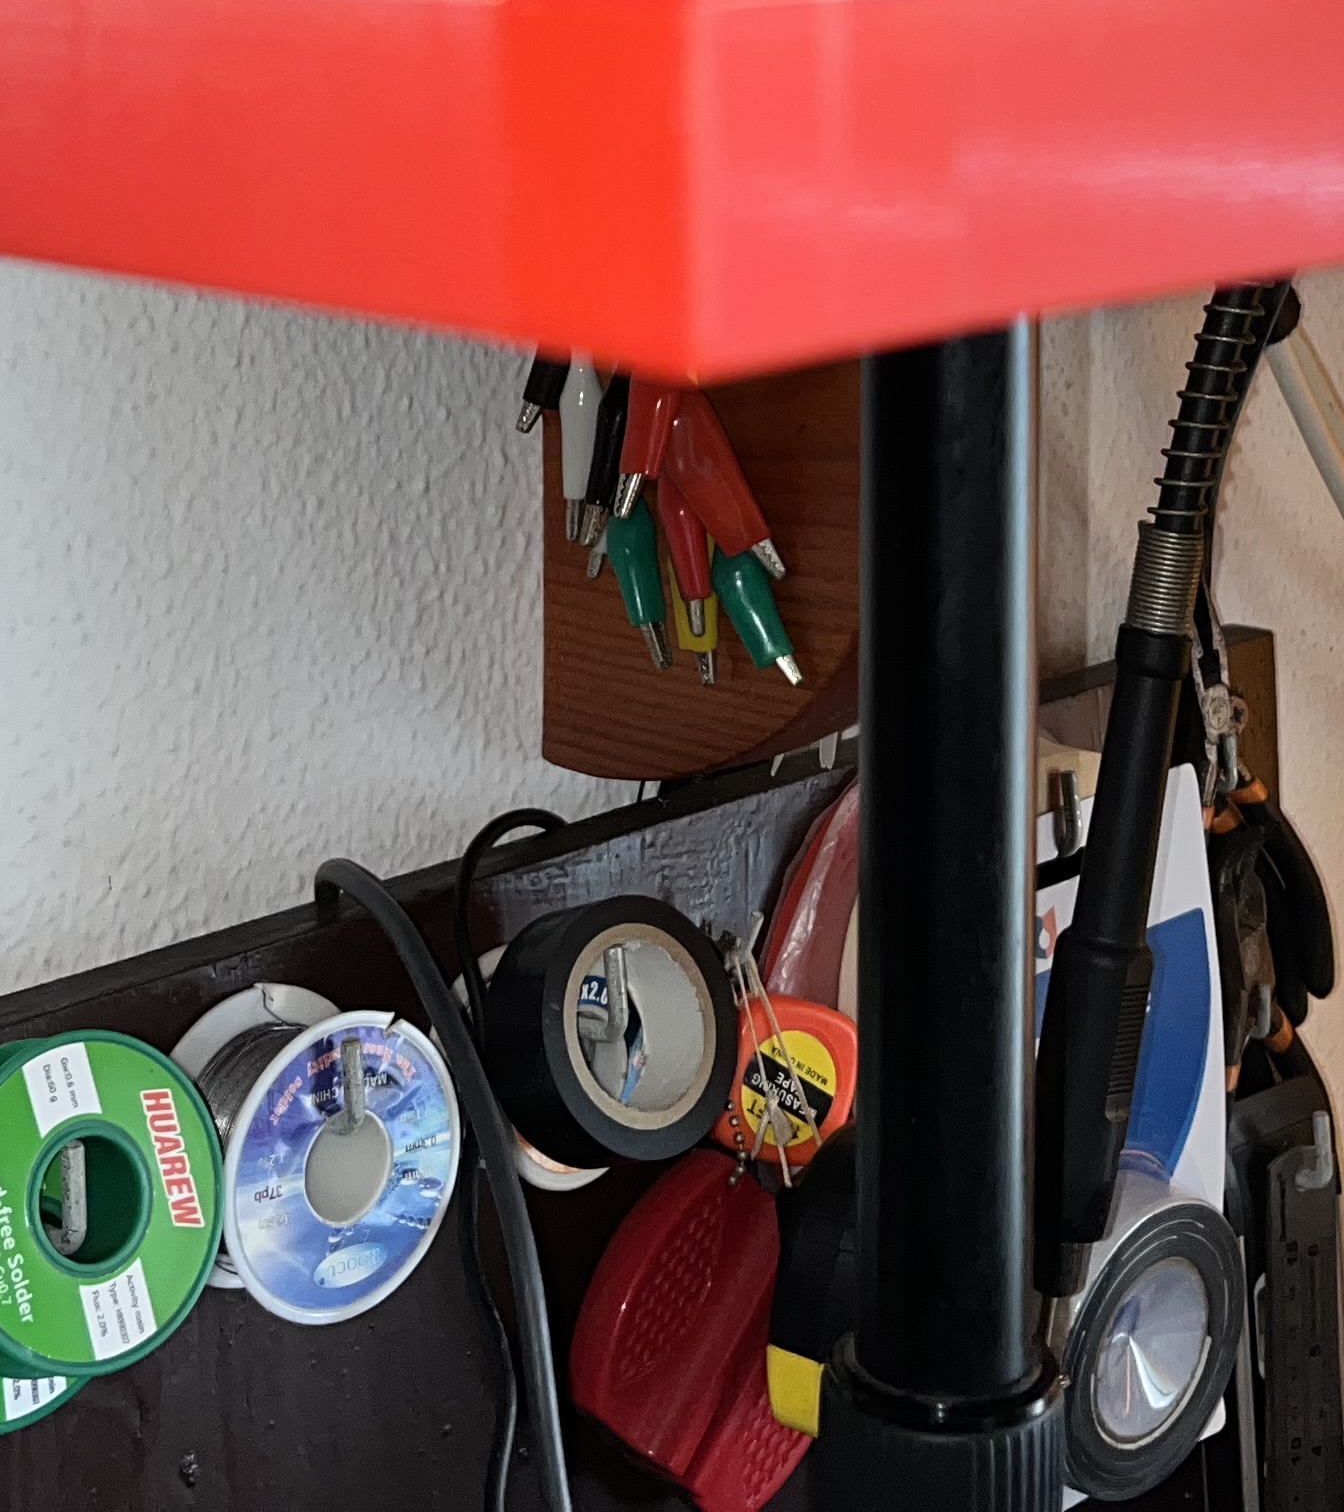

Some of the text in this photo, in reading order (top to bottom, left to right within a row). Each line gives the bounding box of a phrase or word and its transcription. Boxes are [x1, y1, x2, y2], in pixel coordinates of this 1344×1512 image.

[805, 1067, 828, 1086] MADE
[69, 1090, 78, 1108] mm
[141, 1089, 204, 1226] HUAREW
[7, 1253, 34, 1322] Solder
[126, 1275, 139, 1308] Activity
